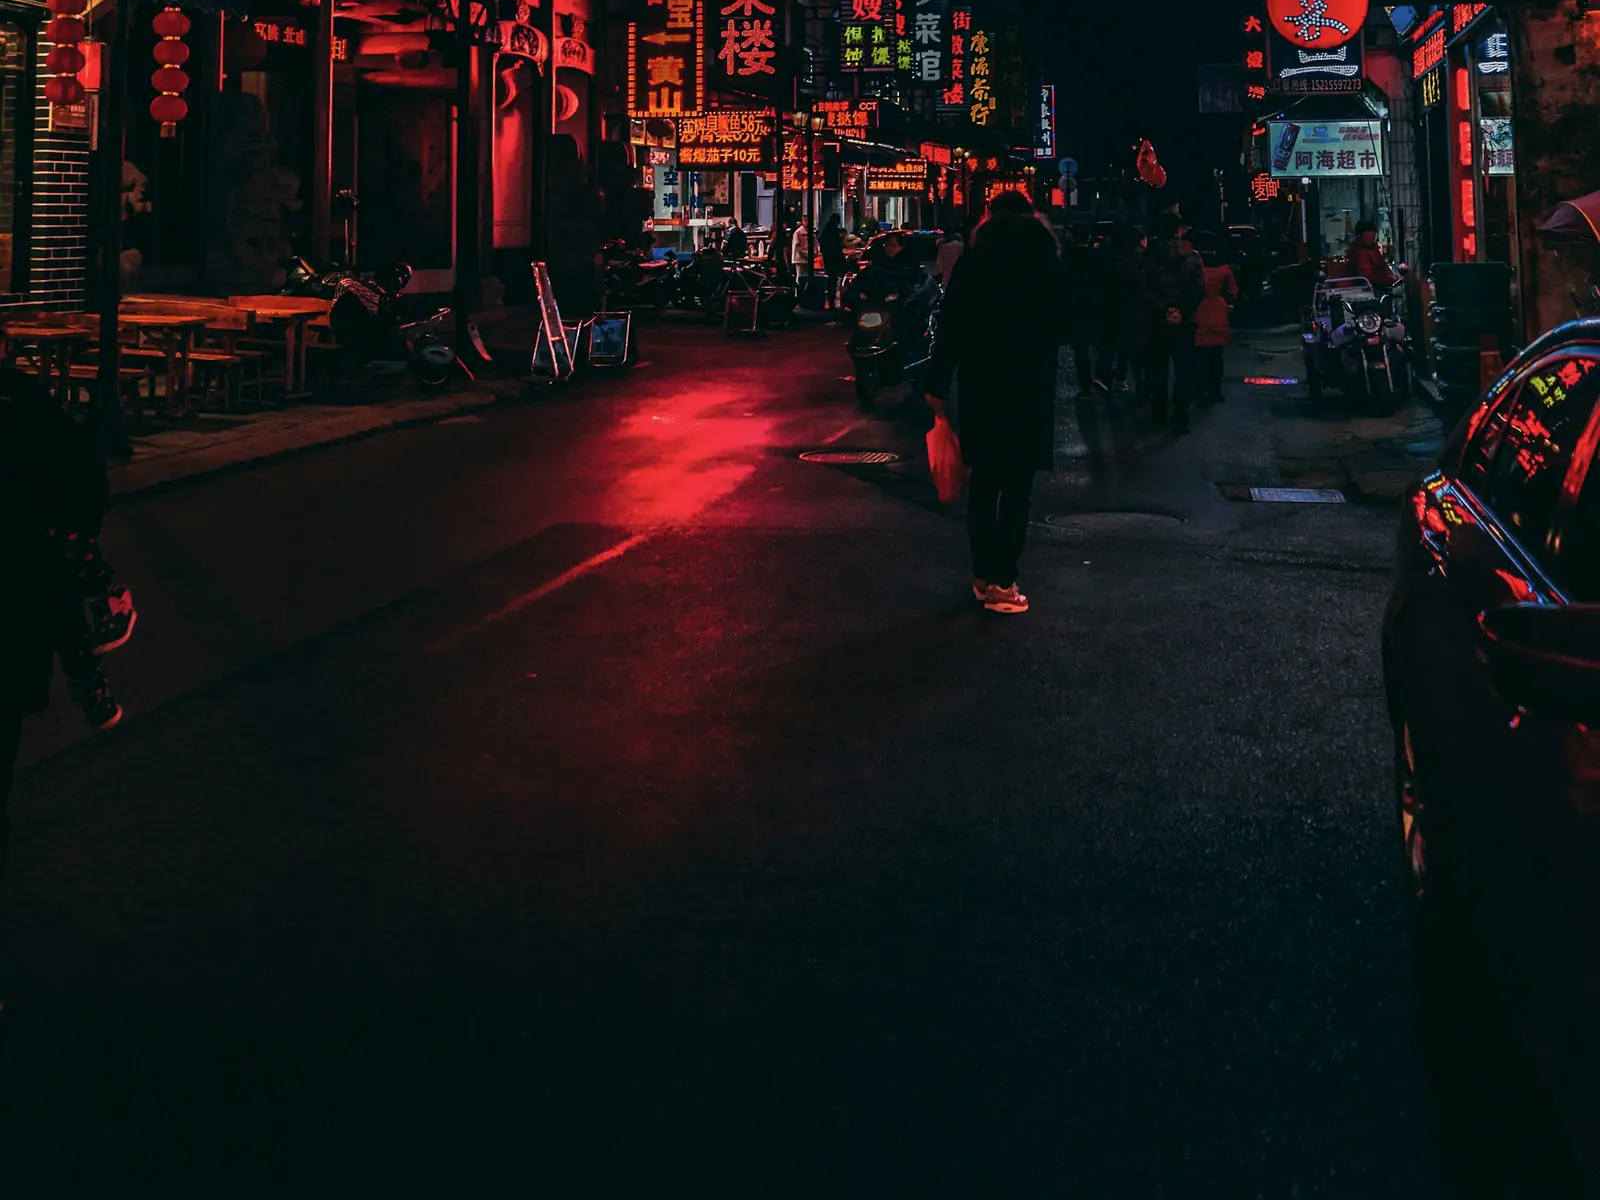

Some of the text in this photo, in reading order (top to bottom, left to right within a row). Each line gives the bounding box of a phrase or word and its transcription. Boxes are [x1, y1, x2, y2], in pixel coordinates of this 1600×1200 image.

[647, 55, 686, 114] 黄山
[680, 147, 761, 164] 酱爆茄子10元
[1295, 150, 1376, 171] 阿海超市
